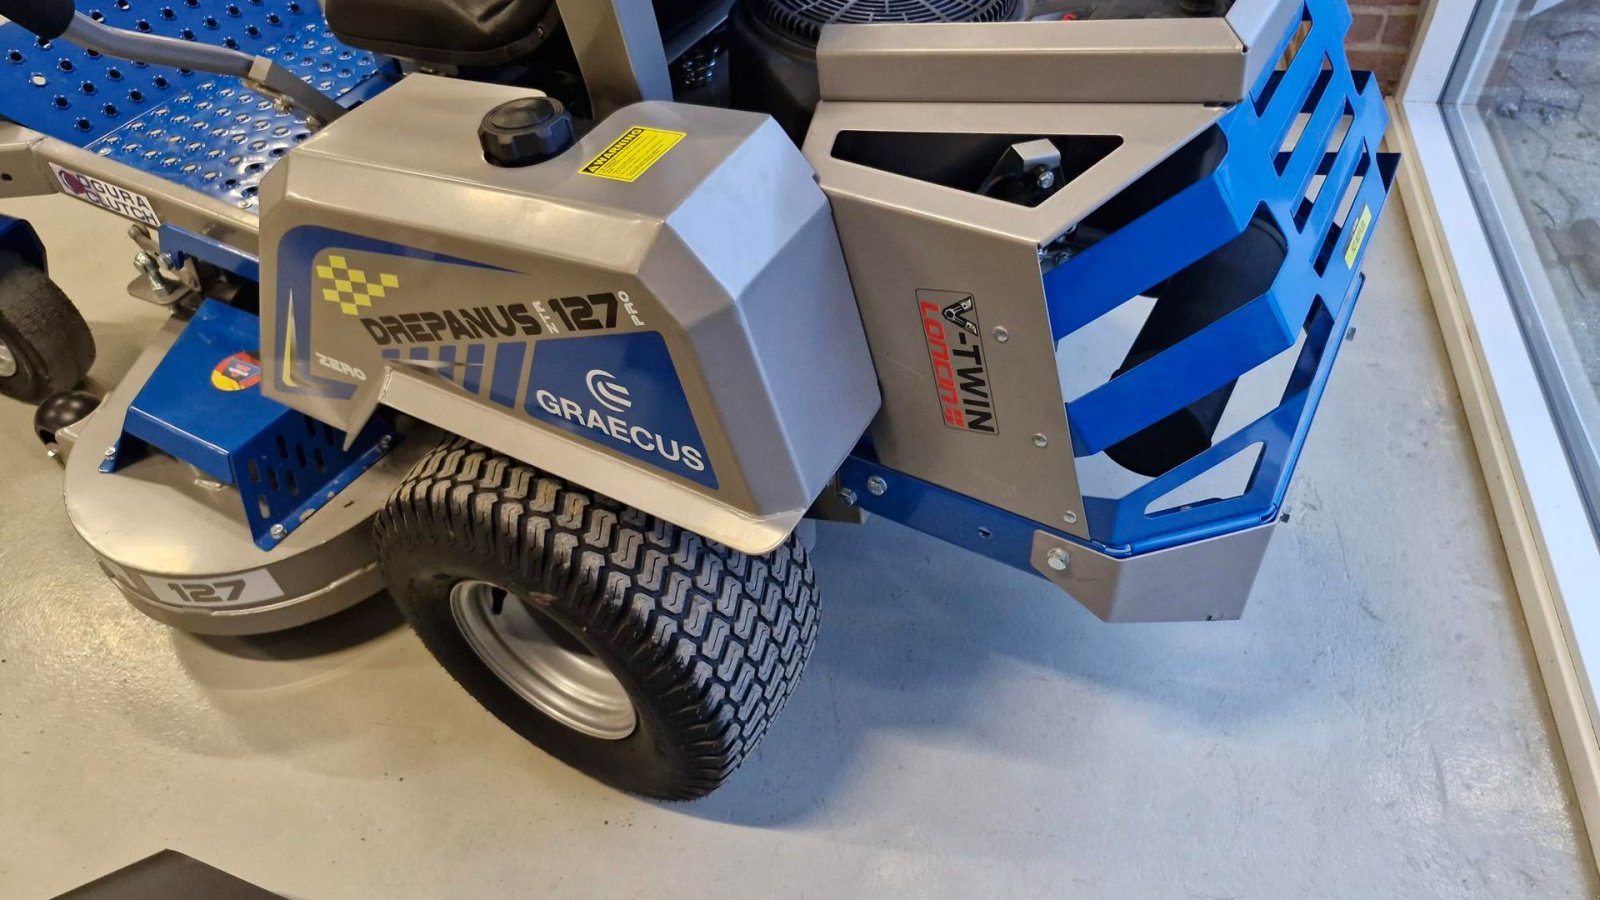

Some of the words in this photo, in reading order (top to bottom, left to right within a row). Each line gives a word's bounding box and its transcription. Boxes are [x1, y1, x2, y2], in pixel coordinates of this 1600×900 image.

[592, 128, 643, 169] WARNING
[76, 174, 150, 210] OGURA
[86, 190, 158, 225] CLUTCH
[360, 303, 542, 346] DREPANUS
[532, 300, 560, 335] ZTR
[548, 292, 619, 332] 127
[617, 290, 645, 327] PRO
[315, 351, 367, 381] ZERO
[536, 389, 705, 471] GRAECUS
[167, 579, 247, 602] 127
